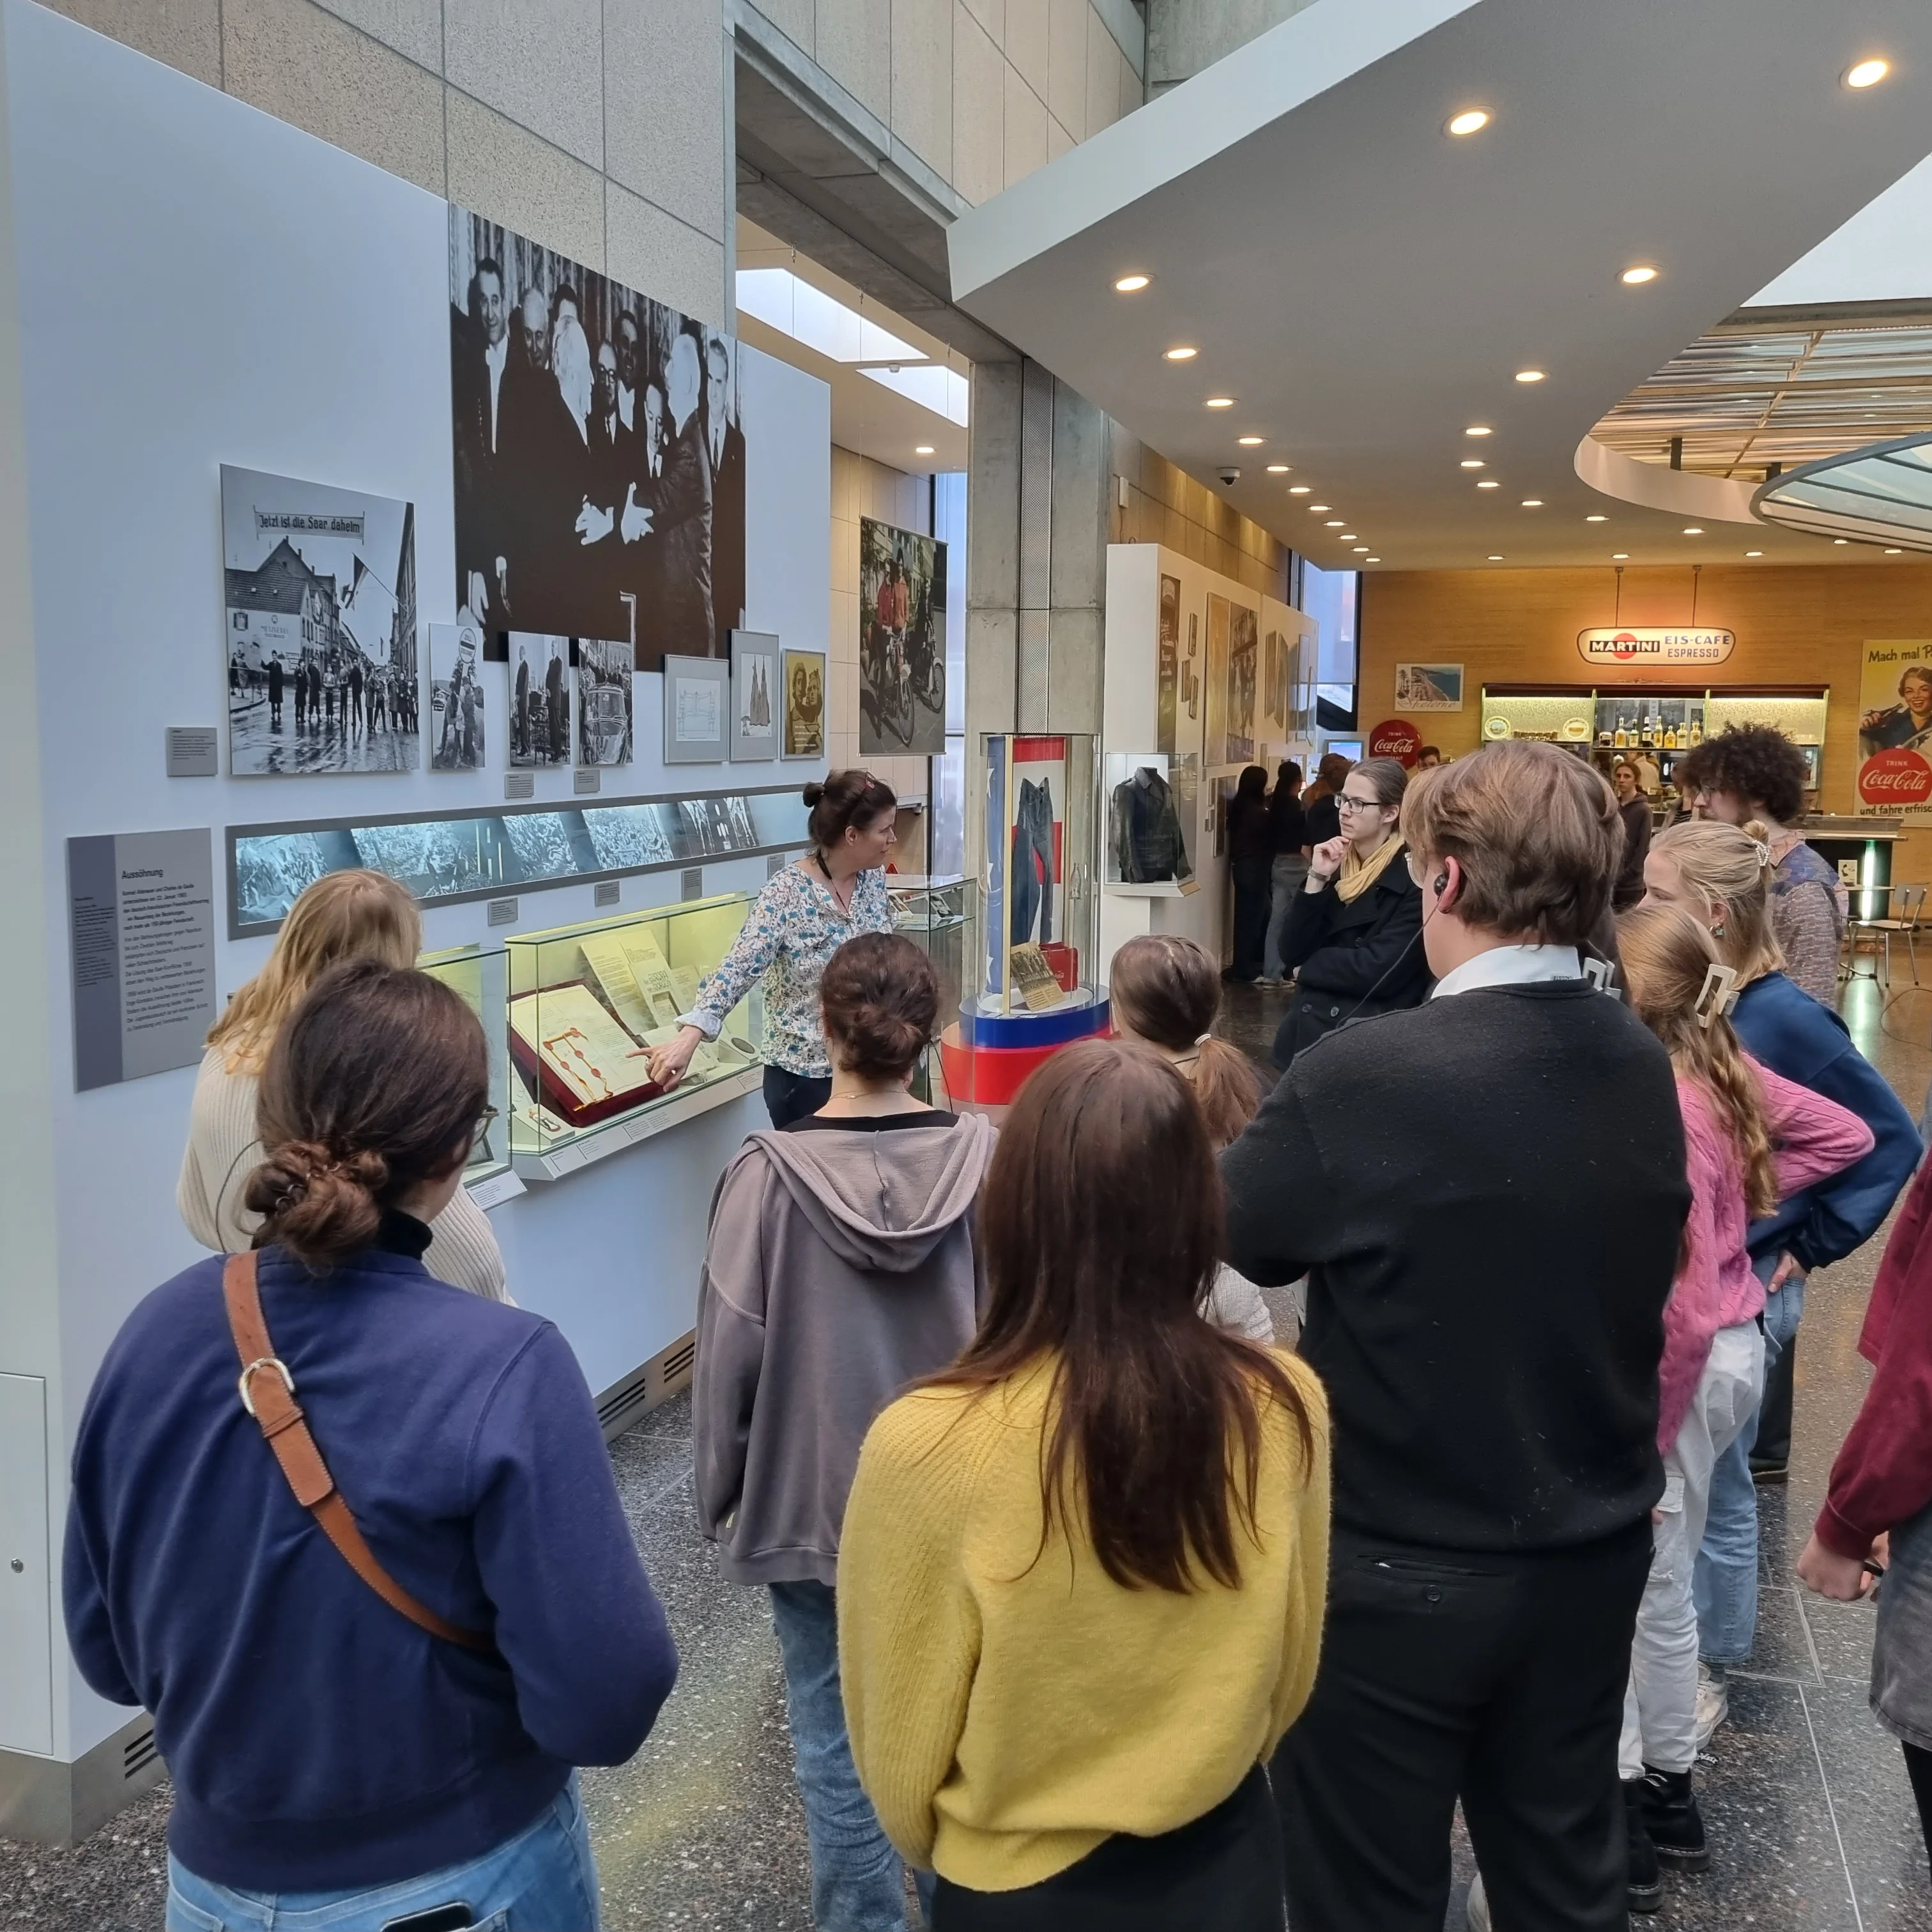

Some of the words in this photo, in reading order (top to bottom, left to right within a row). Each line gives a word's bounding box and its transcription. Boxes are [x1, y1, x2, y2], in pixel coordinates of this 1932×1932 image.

[259, 515, 279, 528] Jetzt
[280, 516, 290, 528] ist
[293, 516, 305, 528] die
[308, 517, 328, 529] Saar
[331, 518, 360, 533] daheim
[1664, 636, 1730, 645] EIS-CAFE
[1591, 641, 1658, 652] MARTINI
[1667, 649, 1719, 657] ESPRESSO
[1868, 648, 1897, 663] Mach
[1901, 647, 1919, 660] mal
[1922, 645, 1932, 659] P
[1374, 739, 1415, 753] Coca-Cola
[1862, 769, 1929, 790] Coca-Cola
[1860, 805, 1876, 815] und
[1879, 805, 1903, 815] fahre
[122, 870, 163, 879] Aussöhnung
